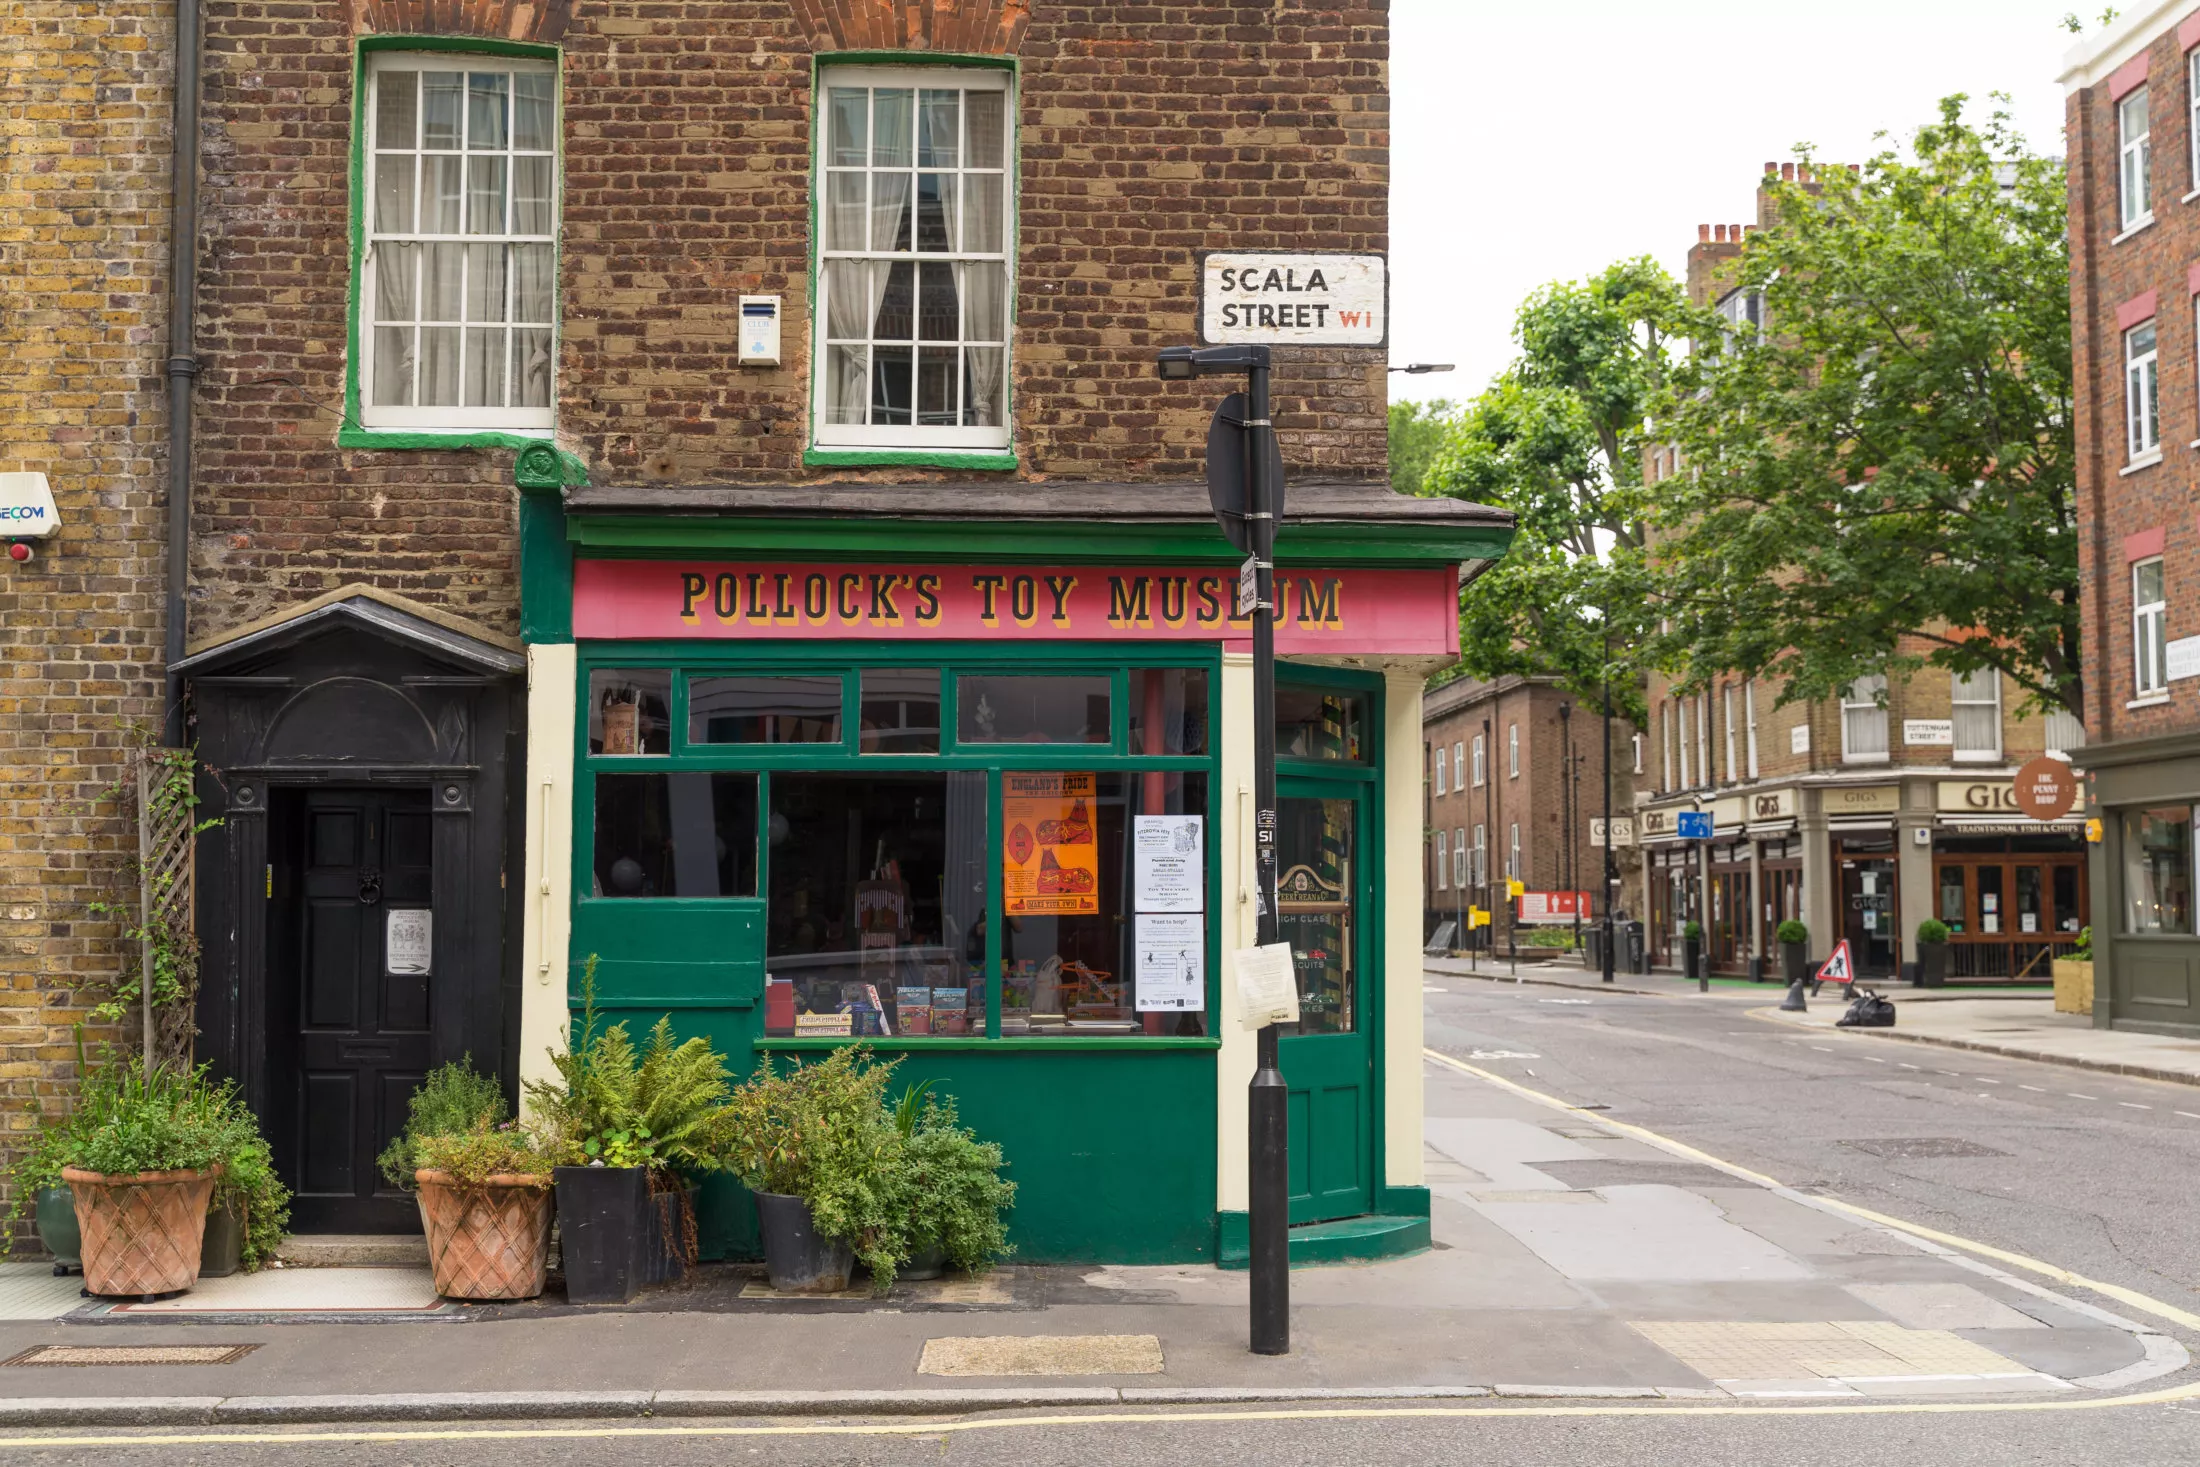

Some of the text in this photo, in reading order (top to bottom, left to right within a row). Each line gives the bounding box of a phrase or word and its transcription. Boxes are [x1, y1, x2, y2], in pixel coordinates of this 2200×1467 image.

[1220, 268, 1328, 292] SCALA
[1222, 303, 1329, 328] STREET
[0, 506, 44, 519] ECOM
[1242, 566, 1254, 586] Except
[680, 572, 942, 627] POLLOCK'S
[974, 574, 1080, 629] TOY
[1242, 588, 1255, 608] cycles
[1011, 777, 1089, 790] ENGLAND'S PRIDE
[1844, 791, 1877, 803] GIGS
[1966, 785, 2016, 808] GIG
[1594, 823, 1630, 836] GGS
[1957, 824, 2017, 833] TRADITIONAL
[1293, 961, 1325, 969] SCUITS
